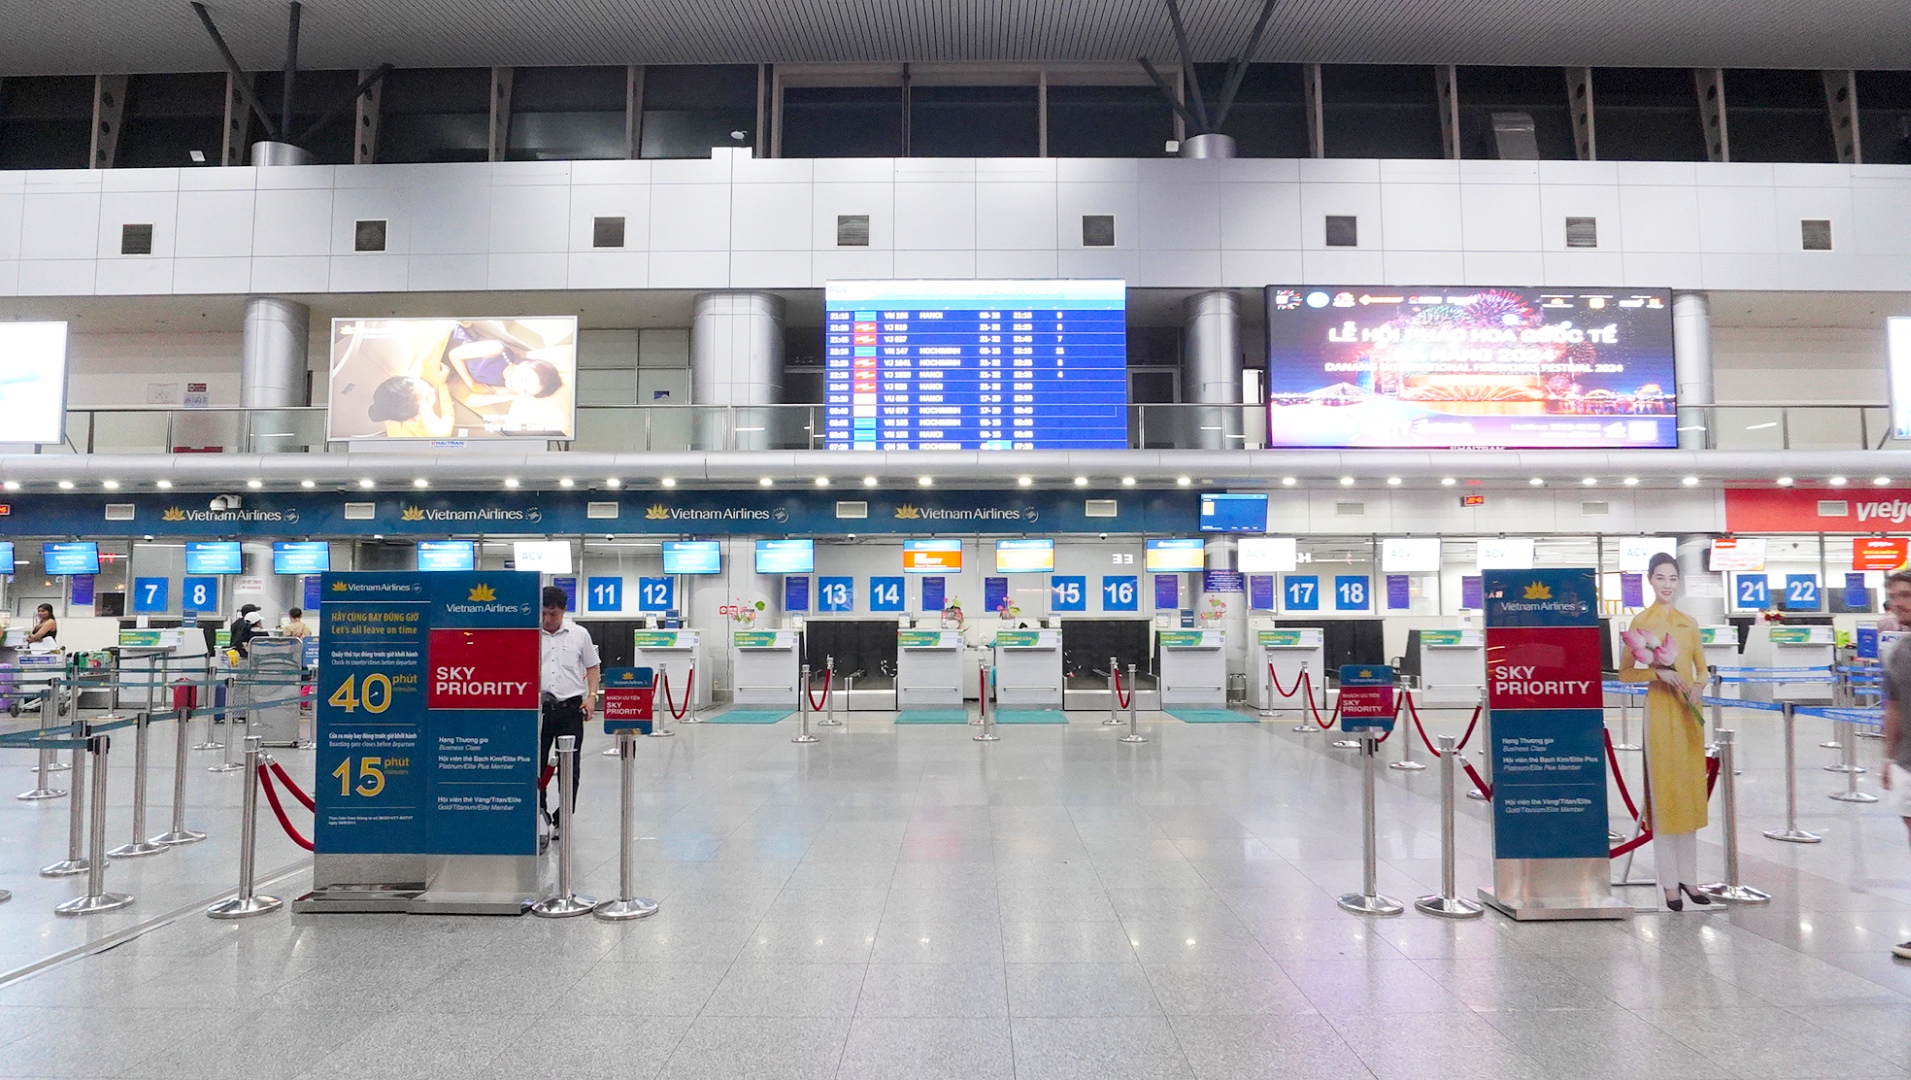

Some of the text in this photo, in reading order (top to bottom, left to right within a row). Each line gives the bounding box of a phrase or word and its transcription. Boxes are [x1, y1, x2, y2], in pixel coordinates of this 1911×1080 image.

[1471, 329, 1517, 342] HOA
[1325, 363, 1378, 372] DANANG
[1542, 364, 1593, 372] FESTIVAL
[1595, 364, 1624, 372] 2024
[186, 510, 282, 520] Vietnam Airlines
[426, 509, 524, 520] Vietnam Airlines
[670, 508, 770, 520] Vietnam Airlines
[920, 508, 1020, 520] Vietnam Airlines
[522, 551, 543, 560] ACV
[1627, 548, 1648, 556] ACV
[145, 584, 158, 604] 7
[193, 584, 206, 604] 8
[594, 584, 614, 604] 11
[644, 584, 667, 604] 12
[822, 584, 847, 604] 13
[874, 584, 900, 604] 14
[1058, 583, 1080, 604] 15
[1108, 583, 1132, 604] 16
[1289, 583, 1314, 604] 17
[1340, 583, 1364, 604] 18
[1741, 581, 1764, 601] 21
[1790, 581, 1815, 601] 22
[446, 604, 518, 612] Vietnam Airlines
[1501, 602, 1575, 611] Vietnam Airlines
[347, 612, 367, 621] CÙNG
[368, 613, 382, 621] BAY
[384, 612, 404, 621] ĐÚNG
[332, 626, 349, 634] Let's
[352, 626, 361, 634] all
[364, 626, 384, 634] leave
[398, 626, 417, 634] time
[392, 674, 417, 685] phút
[436, 666, 476, 680] SKY
[1495, 666, 1535, 680] SKY
[328, 673, 392, 714] 40
[436, 682, 528, 695] PRIORITY
[1496, 681, 1590, 695] PRIORITY
[384, 757, 409, 768] phút
[332, 757, 385, 797] 15
